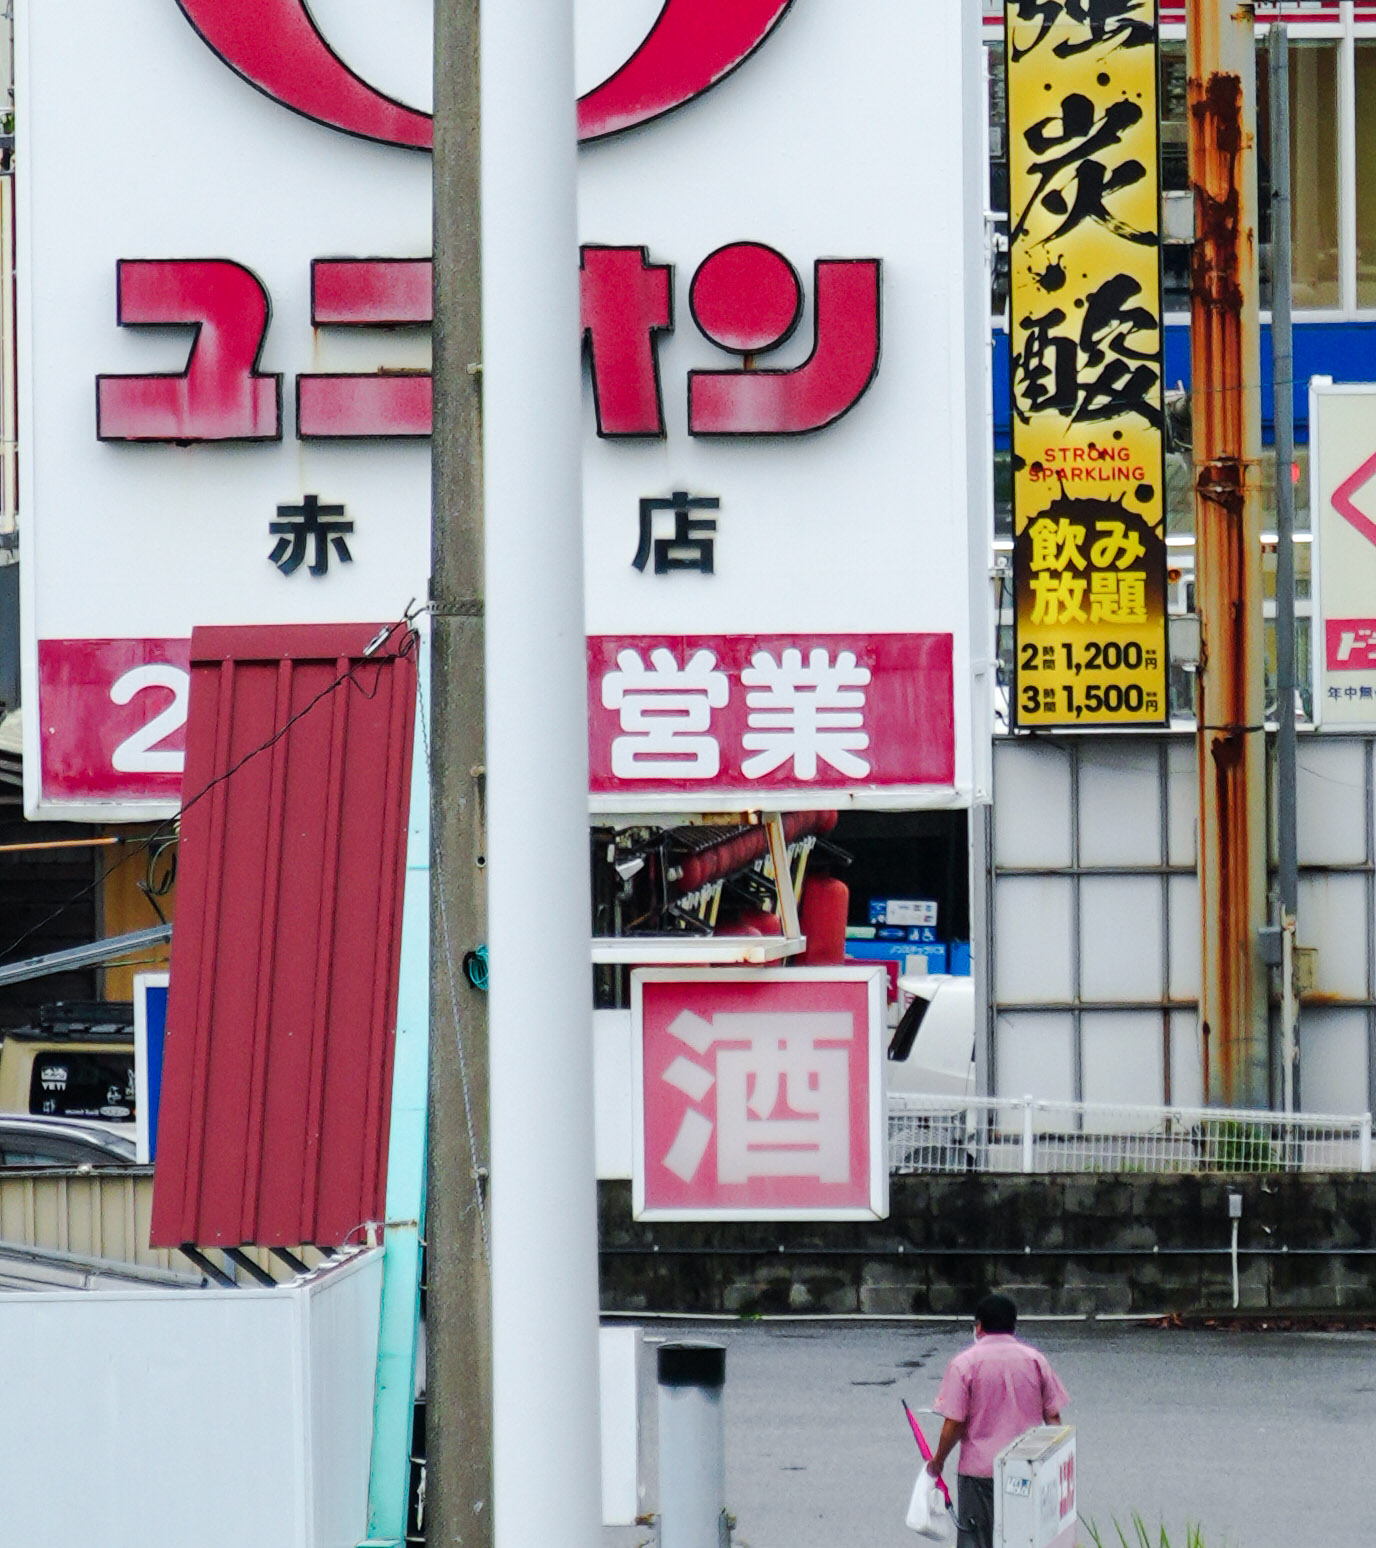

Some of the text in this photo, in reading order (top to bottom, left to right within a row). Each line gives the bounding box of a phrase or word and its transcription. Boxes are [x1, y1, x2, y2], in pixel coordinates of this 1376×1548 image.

[1028, 465, 1146, 482] SPARKLING
[1044, 447, 1131, 463] STRONG
[268, 492, 720, 576] 赤店
[1029, 516, 1147, 572] 飲み
[1029, 571, 1148, 625] 放題
[661, 1009, 854, 1184] 酒
